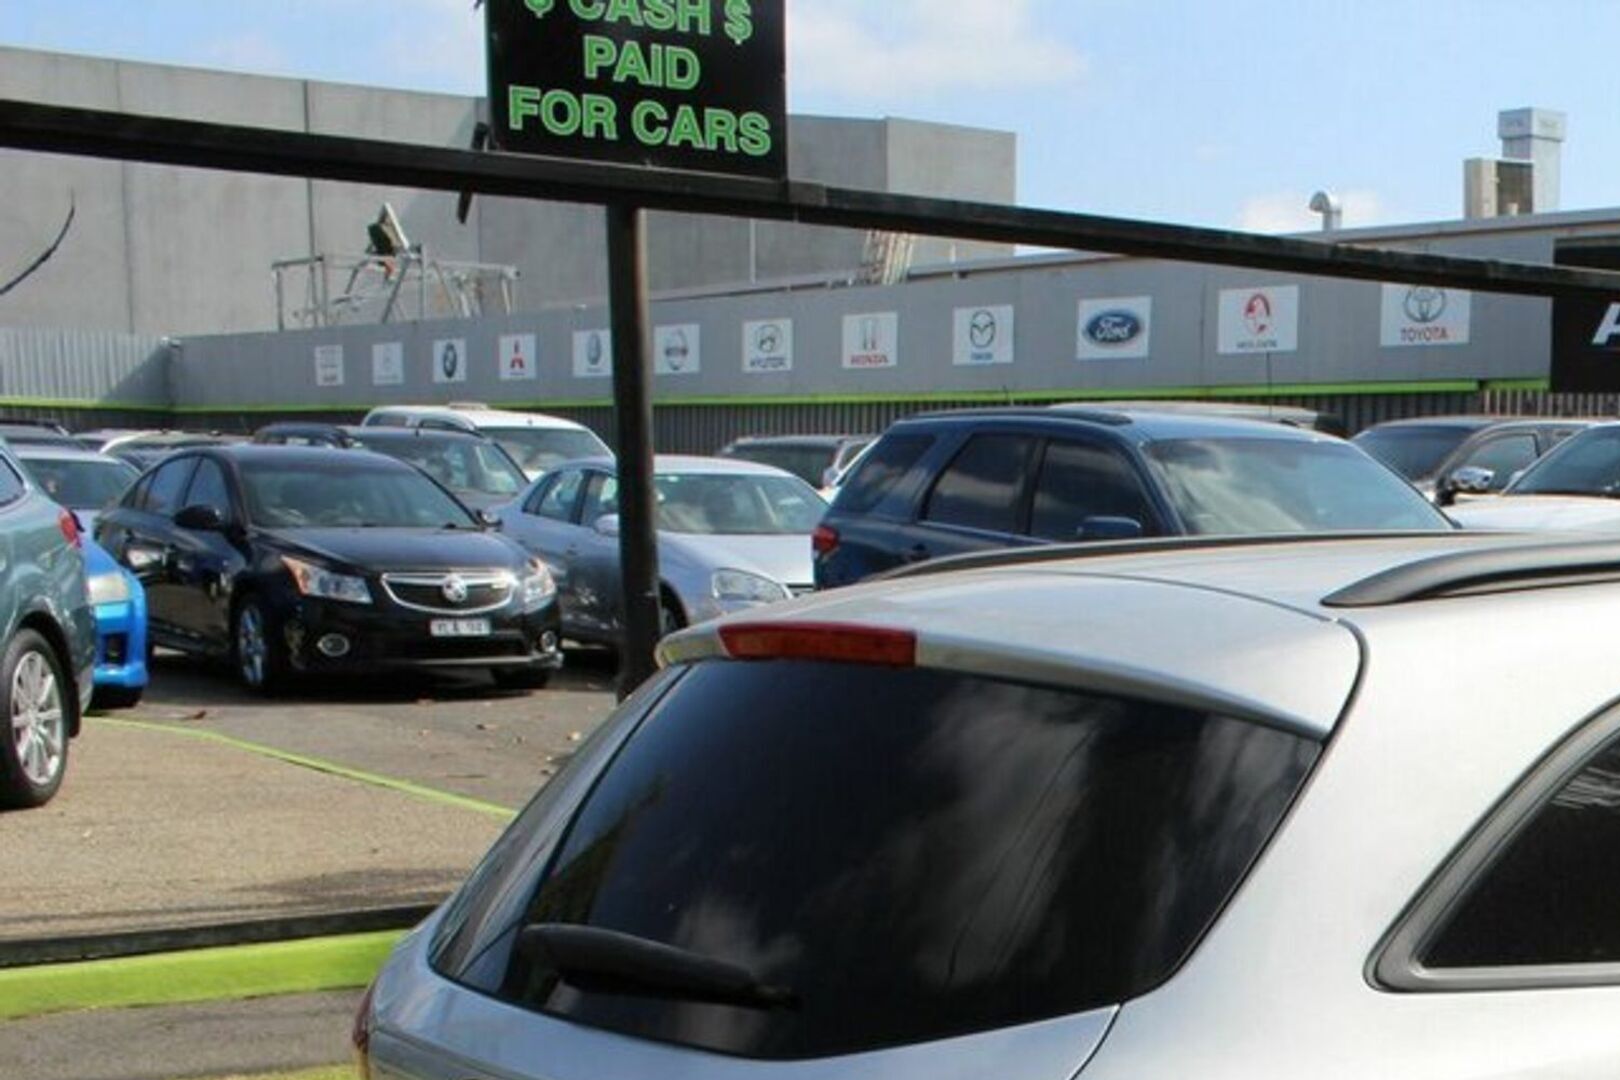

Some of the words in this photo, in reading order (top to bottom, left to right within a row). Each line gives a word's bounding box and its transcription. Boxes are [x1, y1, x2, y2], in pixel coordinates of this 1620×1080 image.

[583, 35, 701, 90] PAID
[508, 85, 618, 140] FOR
[631, 100, 772, 156] CARS
[1095, 316, 1136, 342] Ford
[1400, 326, 1449, 343] TOYOTA
